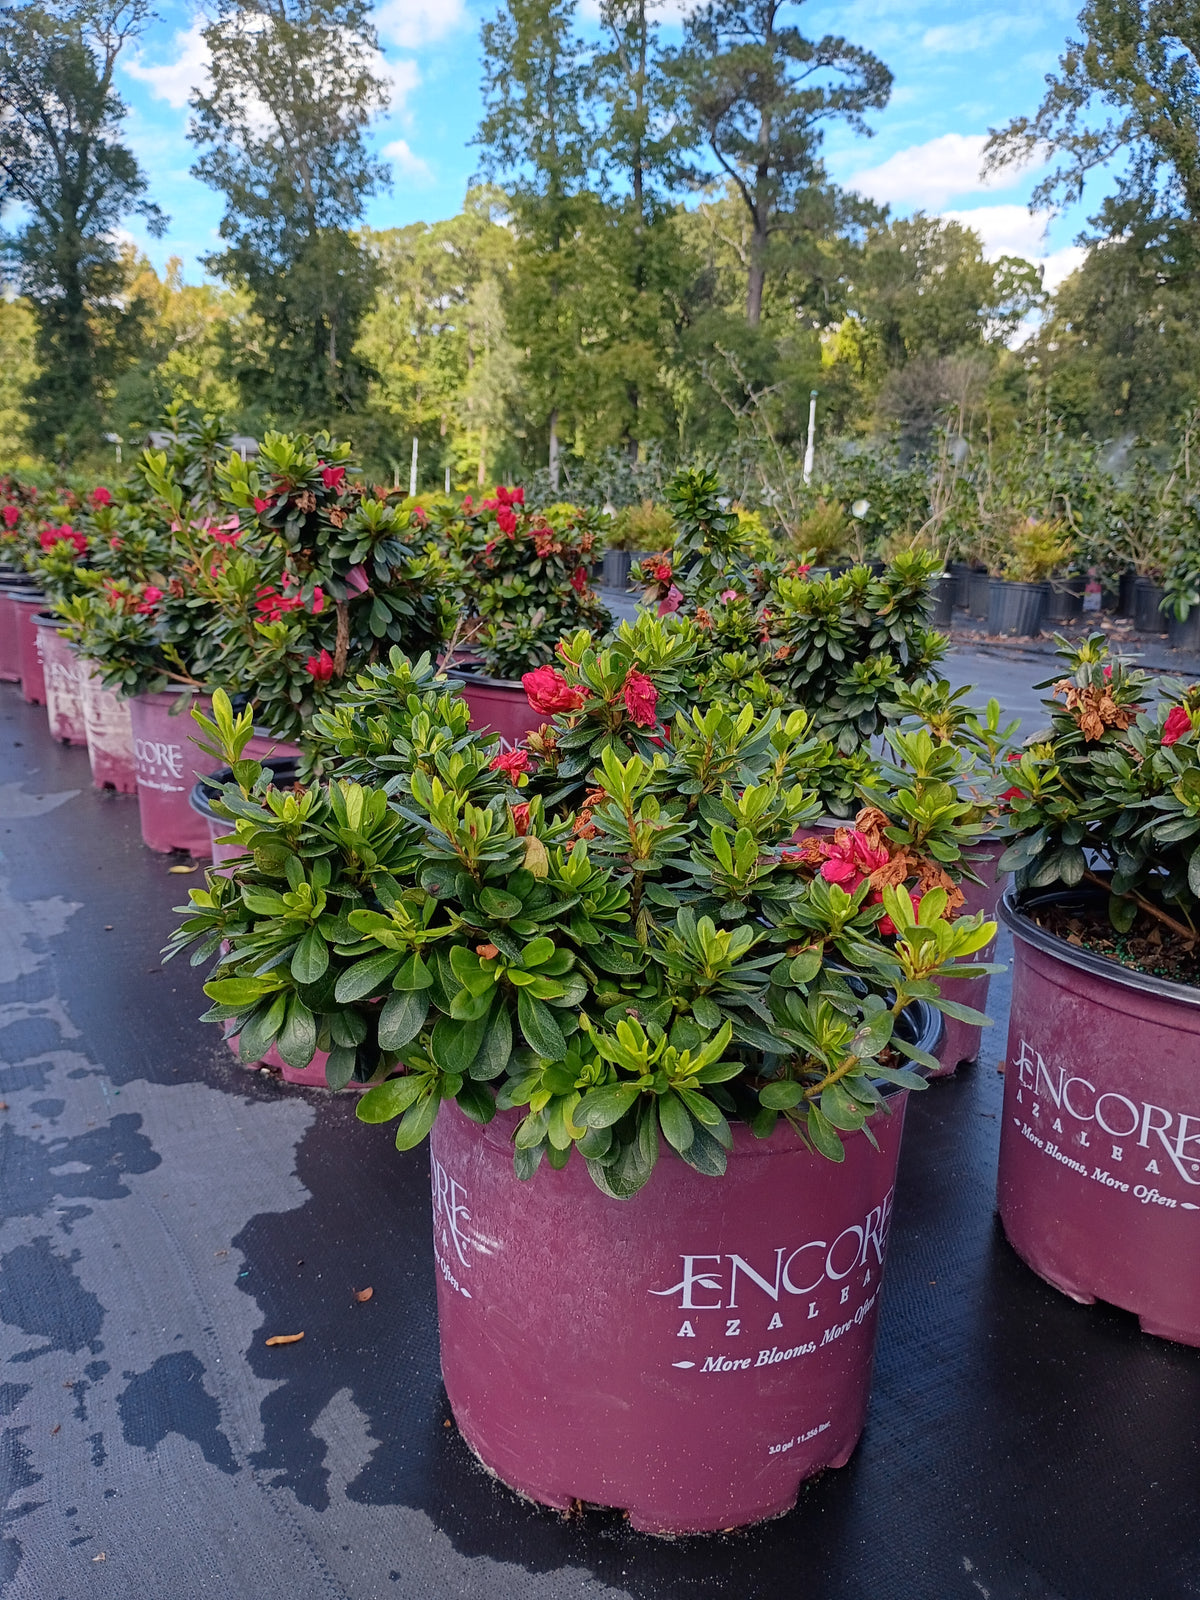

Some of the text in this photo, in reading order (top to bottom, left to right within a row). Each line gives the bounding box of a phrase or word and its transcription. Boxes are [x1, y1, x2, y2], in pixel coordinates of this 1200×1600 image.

[1016, 1088, 1161, 1175] AZALEA
[1021, 1122, 1177, 1208] More Blooms, More Often
[648, 1185, 894, 1310] ENCORE
[677, 1268, 871, 1338] AZALEA
[700, 1356, 751, 1373] More
[754, 1340, 817, 1368] Blooms,
[819, 1319, 854, 1347] More
